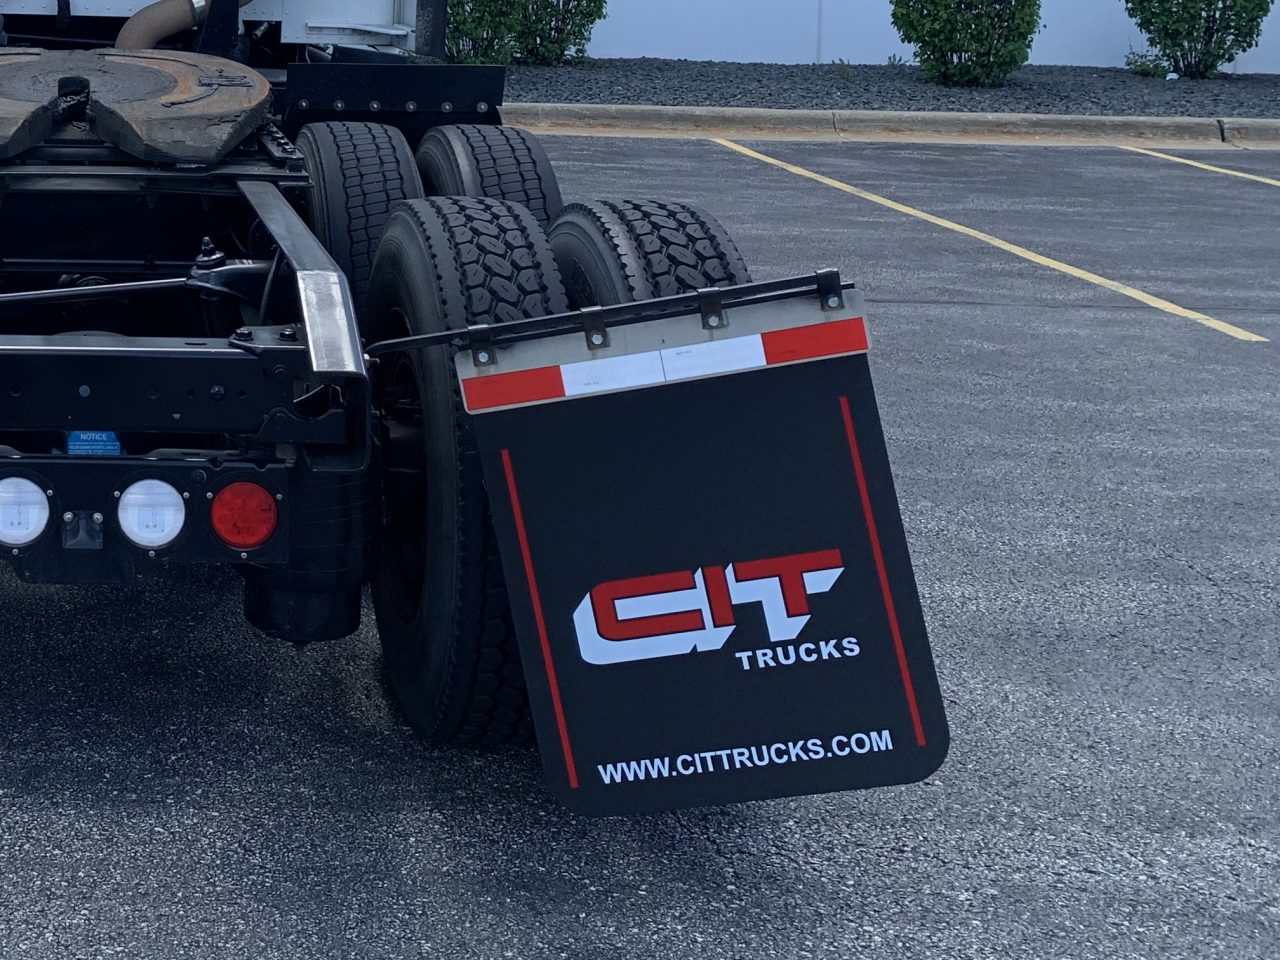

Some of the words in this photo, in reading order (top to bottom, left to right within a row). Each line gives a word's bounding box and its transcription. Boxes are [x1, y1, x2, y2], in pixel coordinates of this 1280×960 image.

[80, 433, 108, 441] NOTICE
[572, 549, 845, 665] CIT
[735, 637, 861, 671] TRUCKS
[598, 729, 893, 785] WWW.CITTRUCKS.COM
